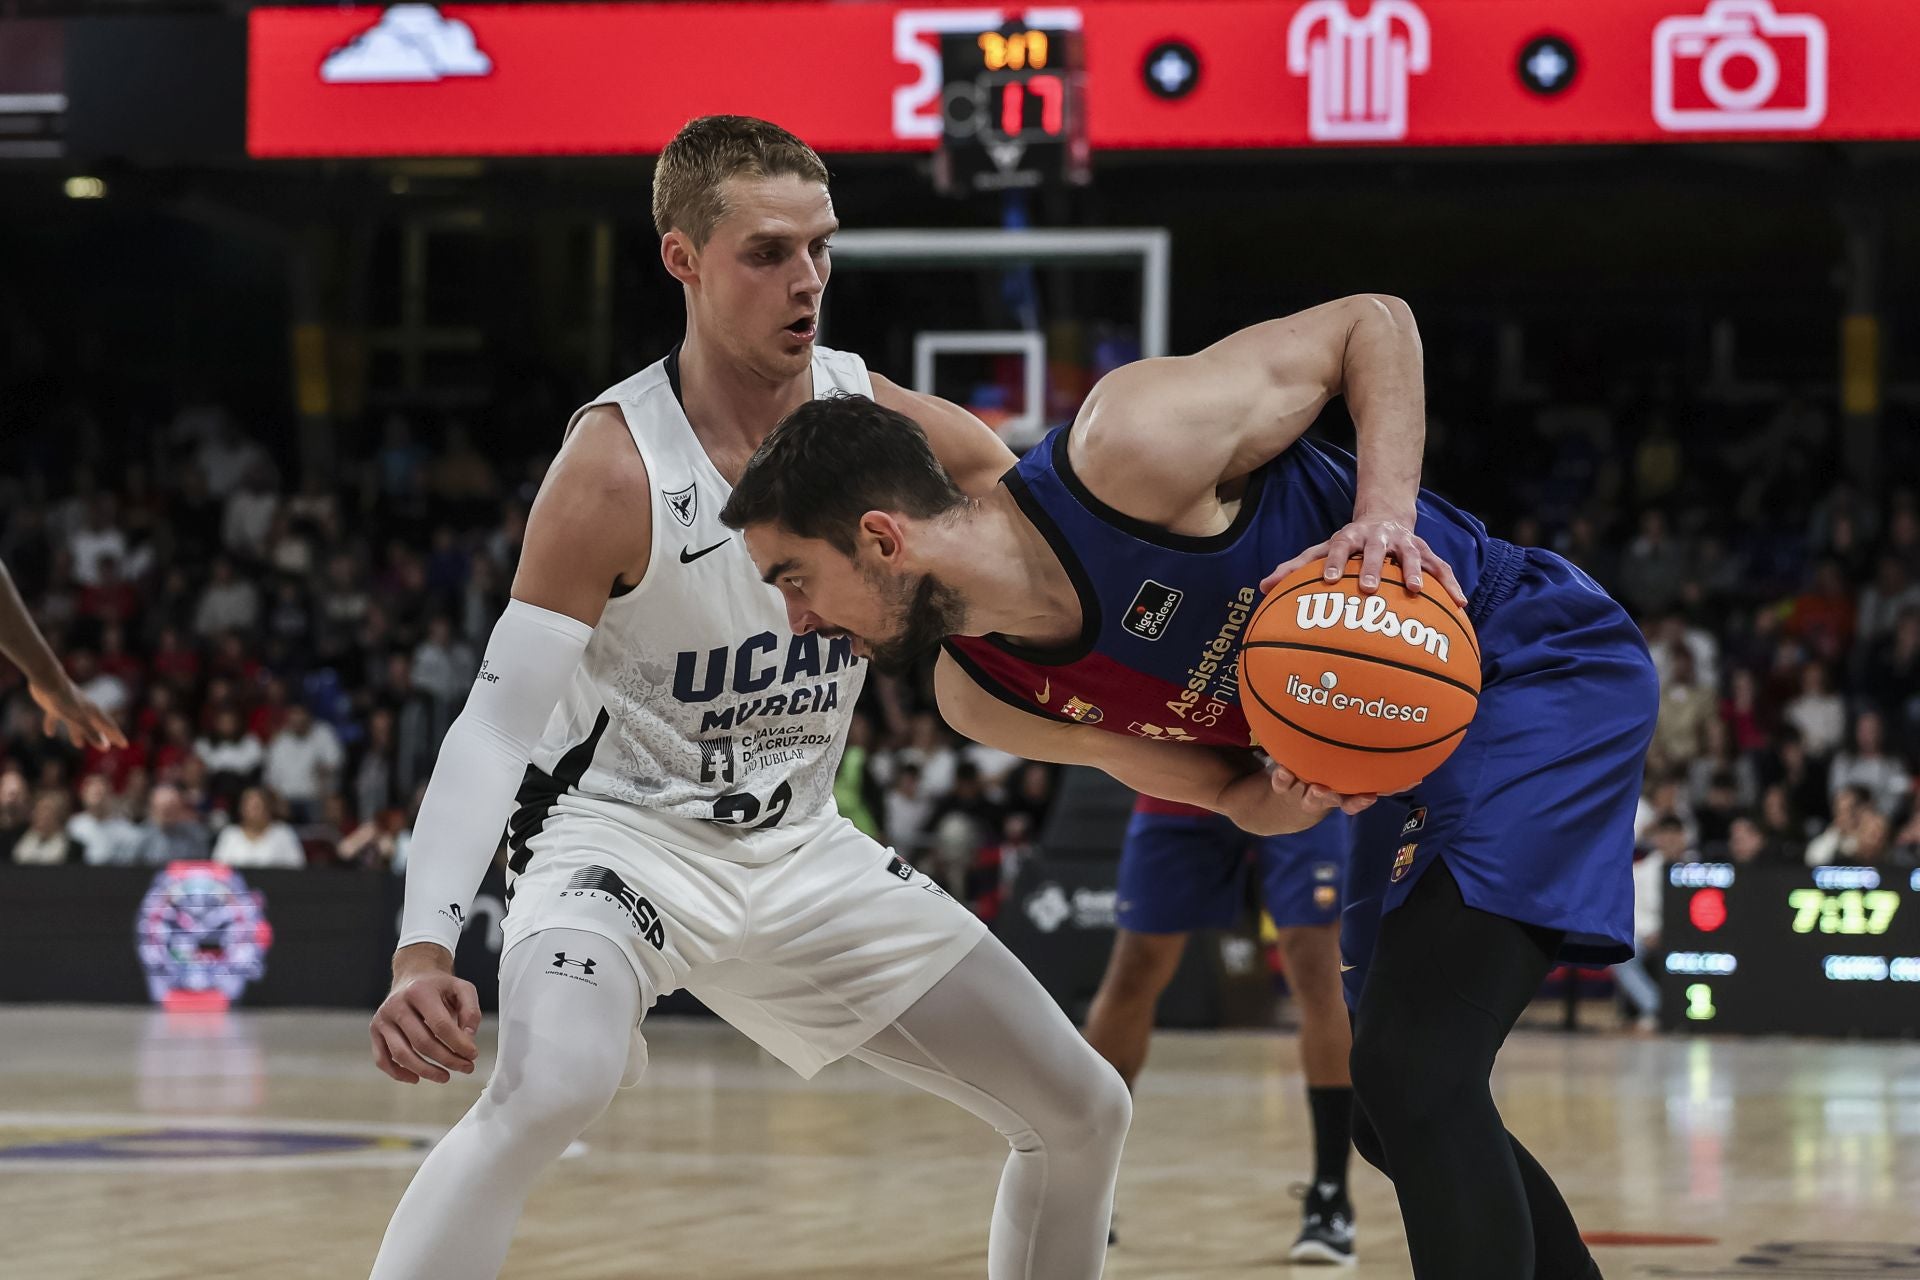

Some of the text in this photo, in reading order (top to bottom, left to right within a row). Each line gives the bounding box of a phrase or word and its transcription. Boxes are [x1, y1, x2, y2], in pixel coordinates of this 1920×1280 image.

[1002, 76, 1063, 136] 17
[1135, 611, 1154, 632] liga
[1148, 593, 1177, 635] endesa
[1296, 592, 1450, 663] Wilson
[1166, 586, 1255, 718] Assistència
[700, 681, 838, 733] MURCIA
[1286, 674, 1428, 723] liga endesa
[760, 749, 804, 770] JUBILAR
[766, 736, 799, 750] CRUZ
[800, 734, 831, 745] 2024
[1403, 818, 1418, 832] acb
[619, 886, 665, 951] ESP
[1789, 888, 1900, 935] 7:17
